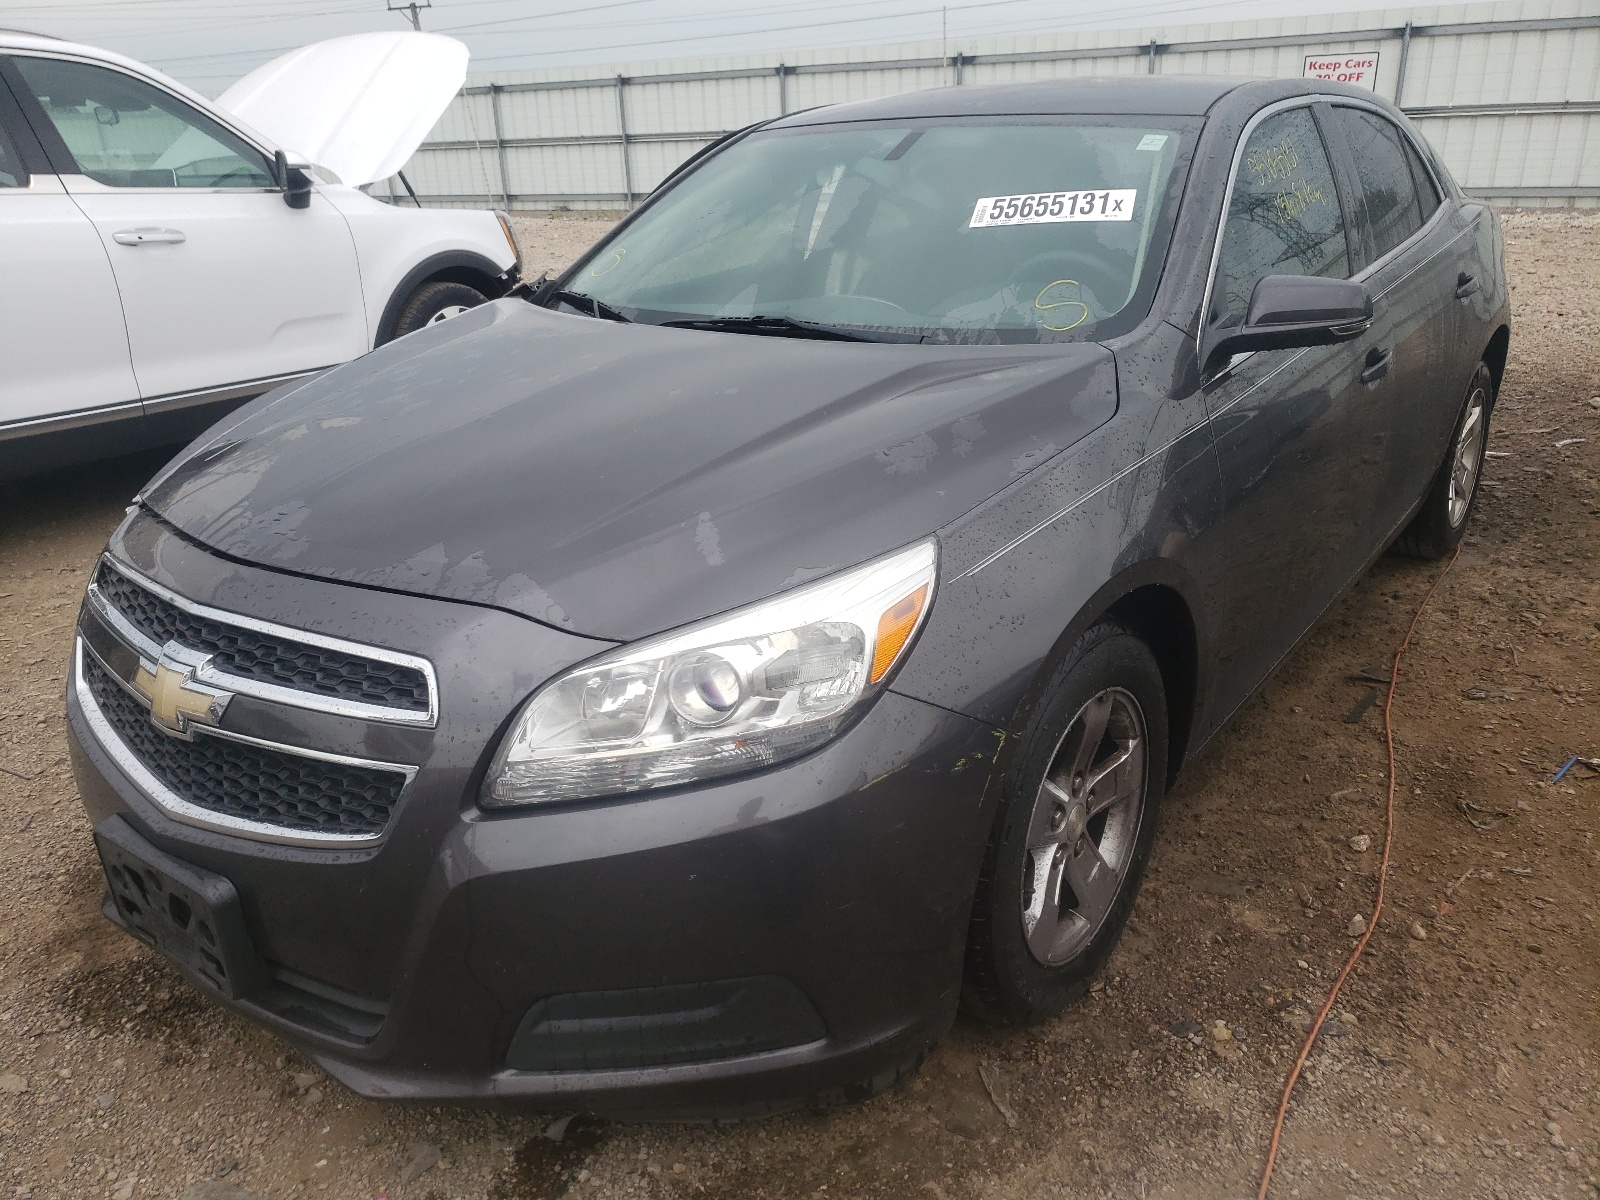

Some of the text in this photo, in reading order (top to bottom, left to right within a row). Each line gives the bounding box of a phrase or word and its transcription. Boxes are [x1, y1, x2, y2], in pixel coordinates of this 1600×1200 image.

[1309, 59, 1374, 72] Keep Cars
[1336, 72, 1365, 83] OFF
[989, 192, 1110, 220] 55655131
[1036, 279, 1088, 331] S
